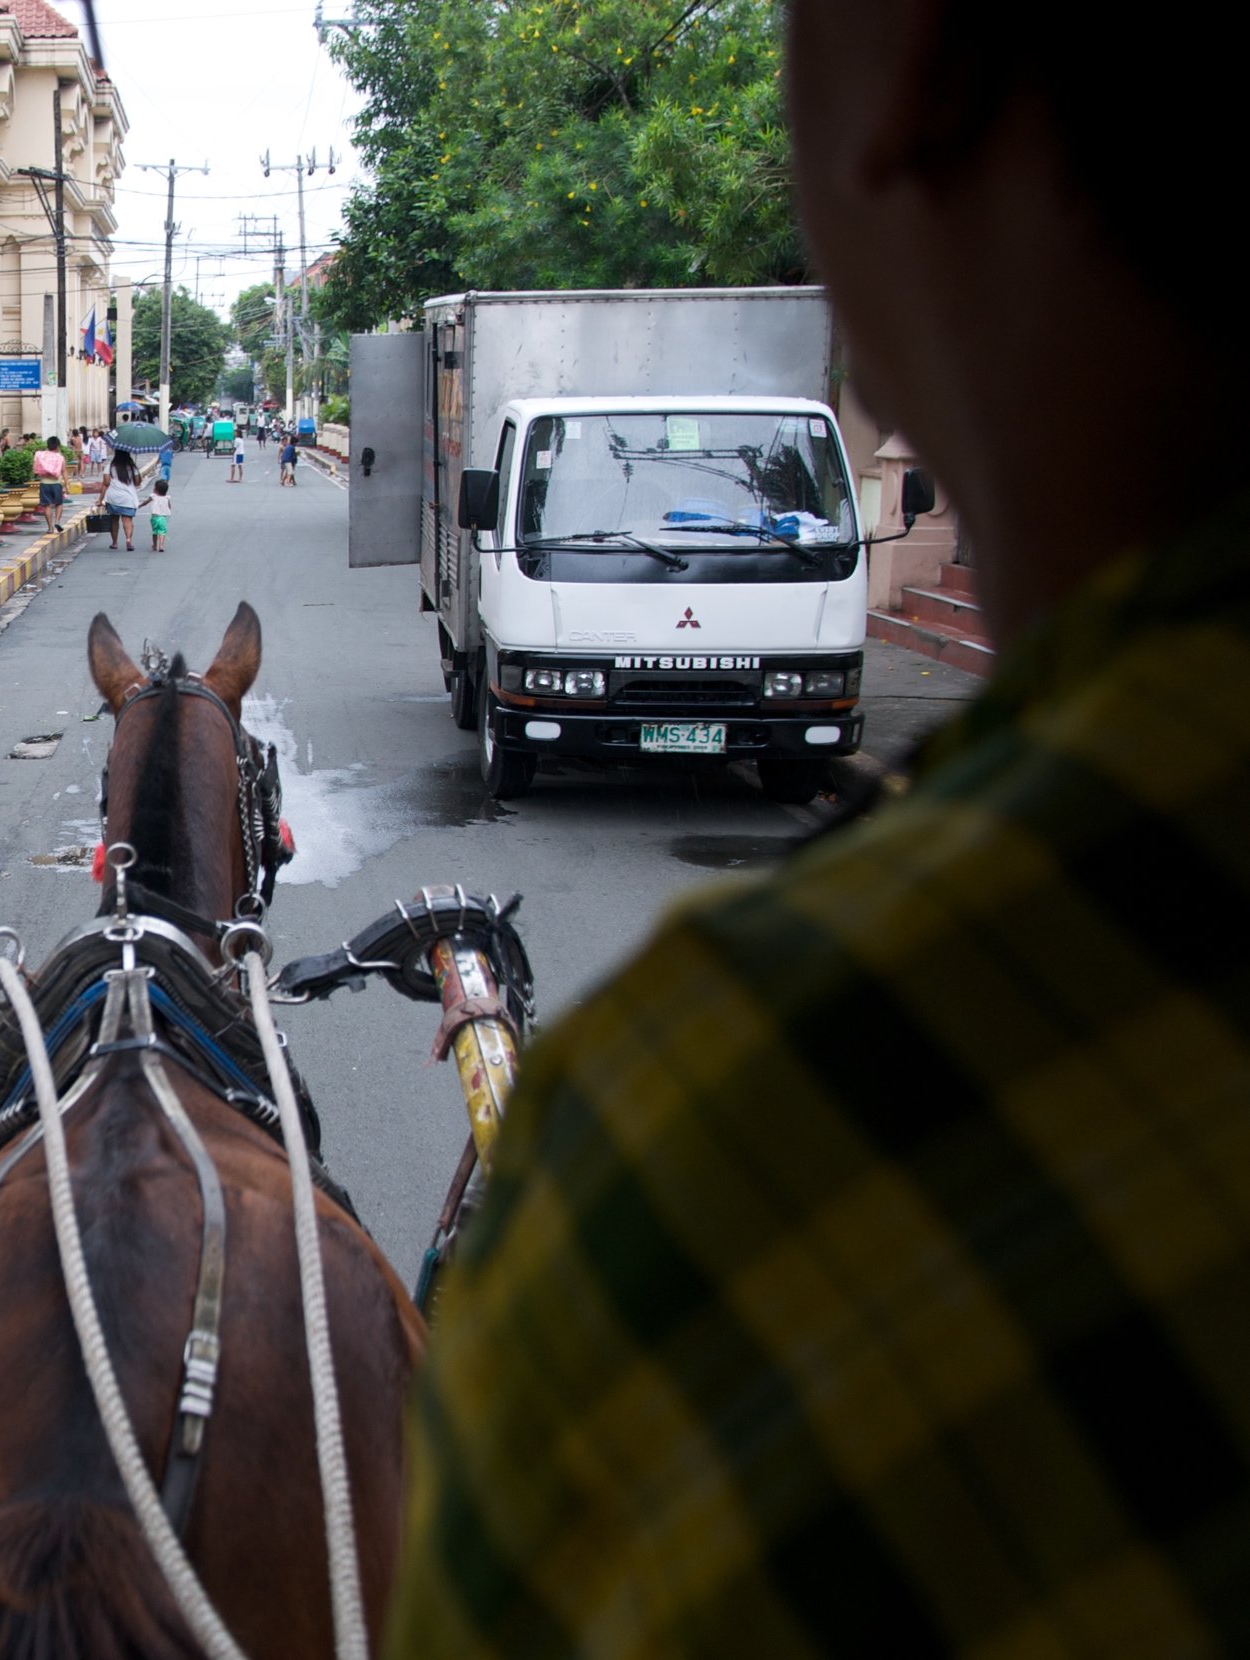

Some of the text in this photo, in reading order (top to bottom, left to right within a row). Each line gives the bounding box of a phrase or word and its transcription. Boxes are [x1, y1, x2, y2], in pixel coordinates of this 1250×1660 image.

[568, 631, 637, 642] CANTER
[614, 656, 760, 669] MITSUBISHI
[642, 726, 722, 744] WMS-434
